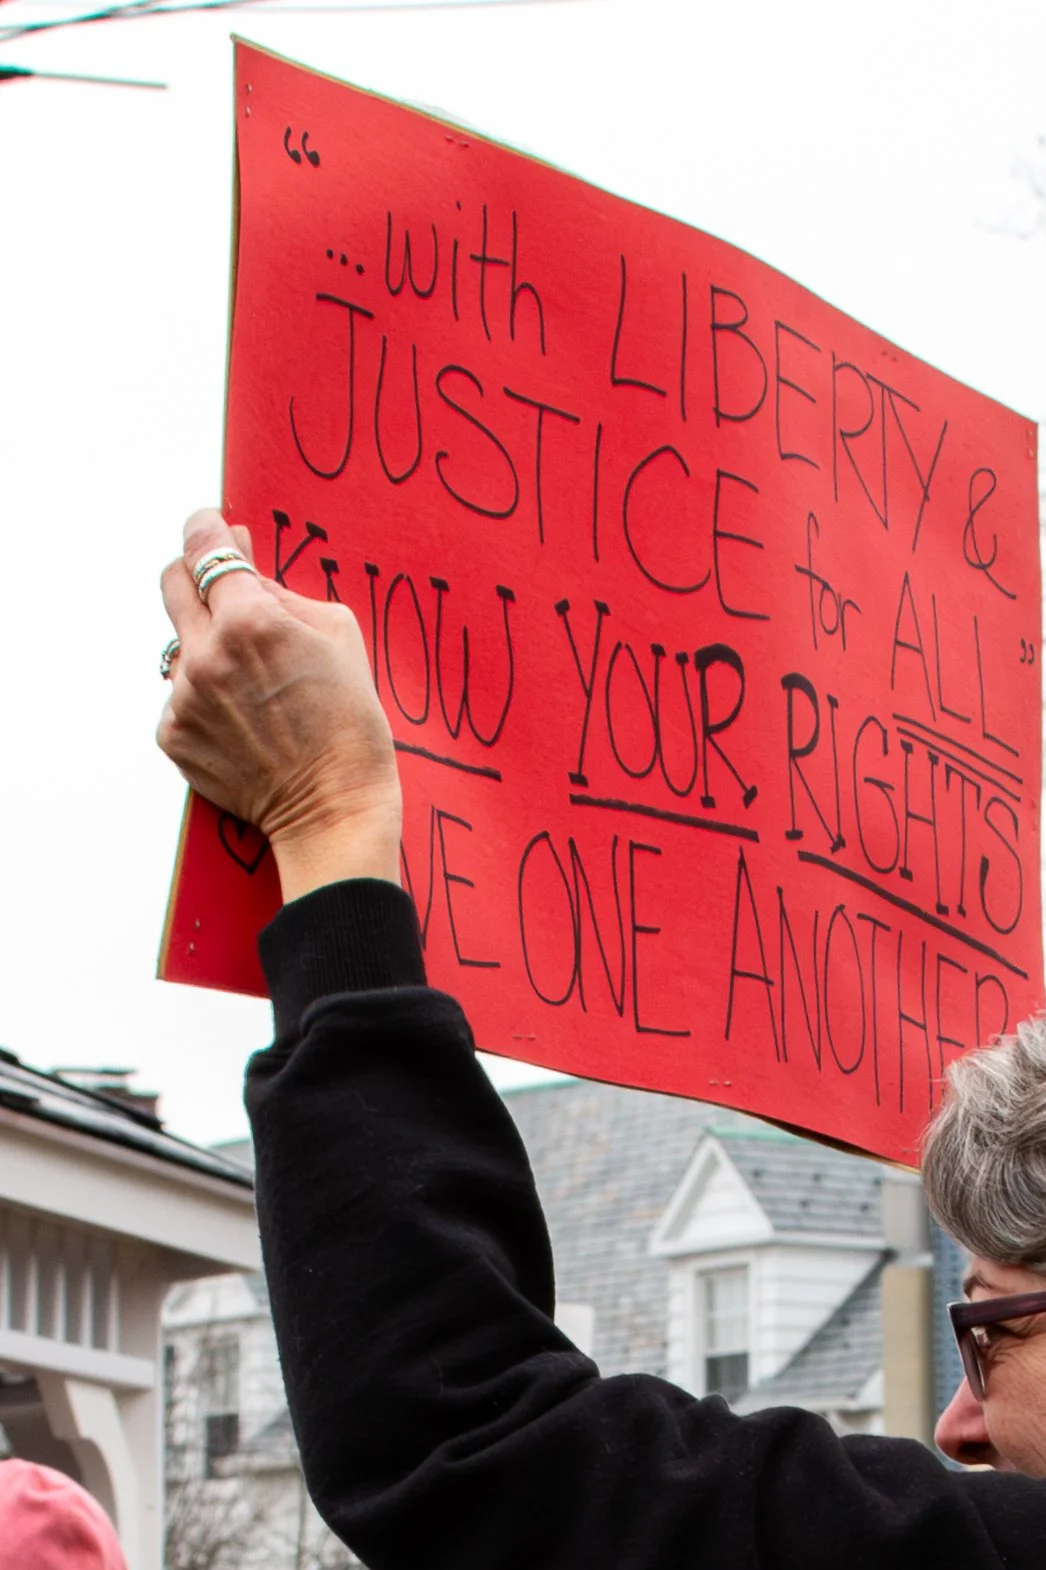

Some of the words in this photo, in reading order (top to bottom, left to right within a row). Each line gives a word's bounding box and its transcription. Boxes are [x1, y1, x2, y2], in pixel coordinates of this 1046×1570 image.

[290, 293, 770, 621] JUSTICE
[794, 510, 863, 653] for
[611, 253, 949, 553] LIBERTY
[962, 466, 1017, 600] &
[518, 831, 691, 1040] ONE
[554, 598, 758, 809] YOUR
[780, 671, 1024, 936] RIGHTS
